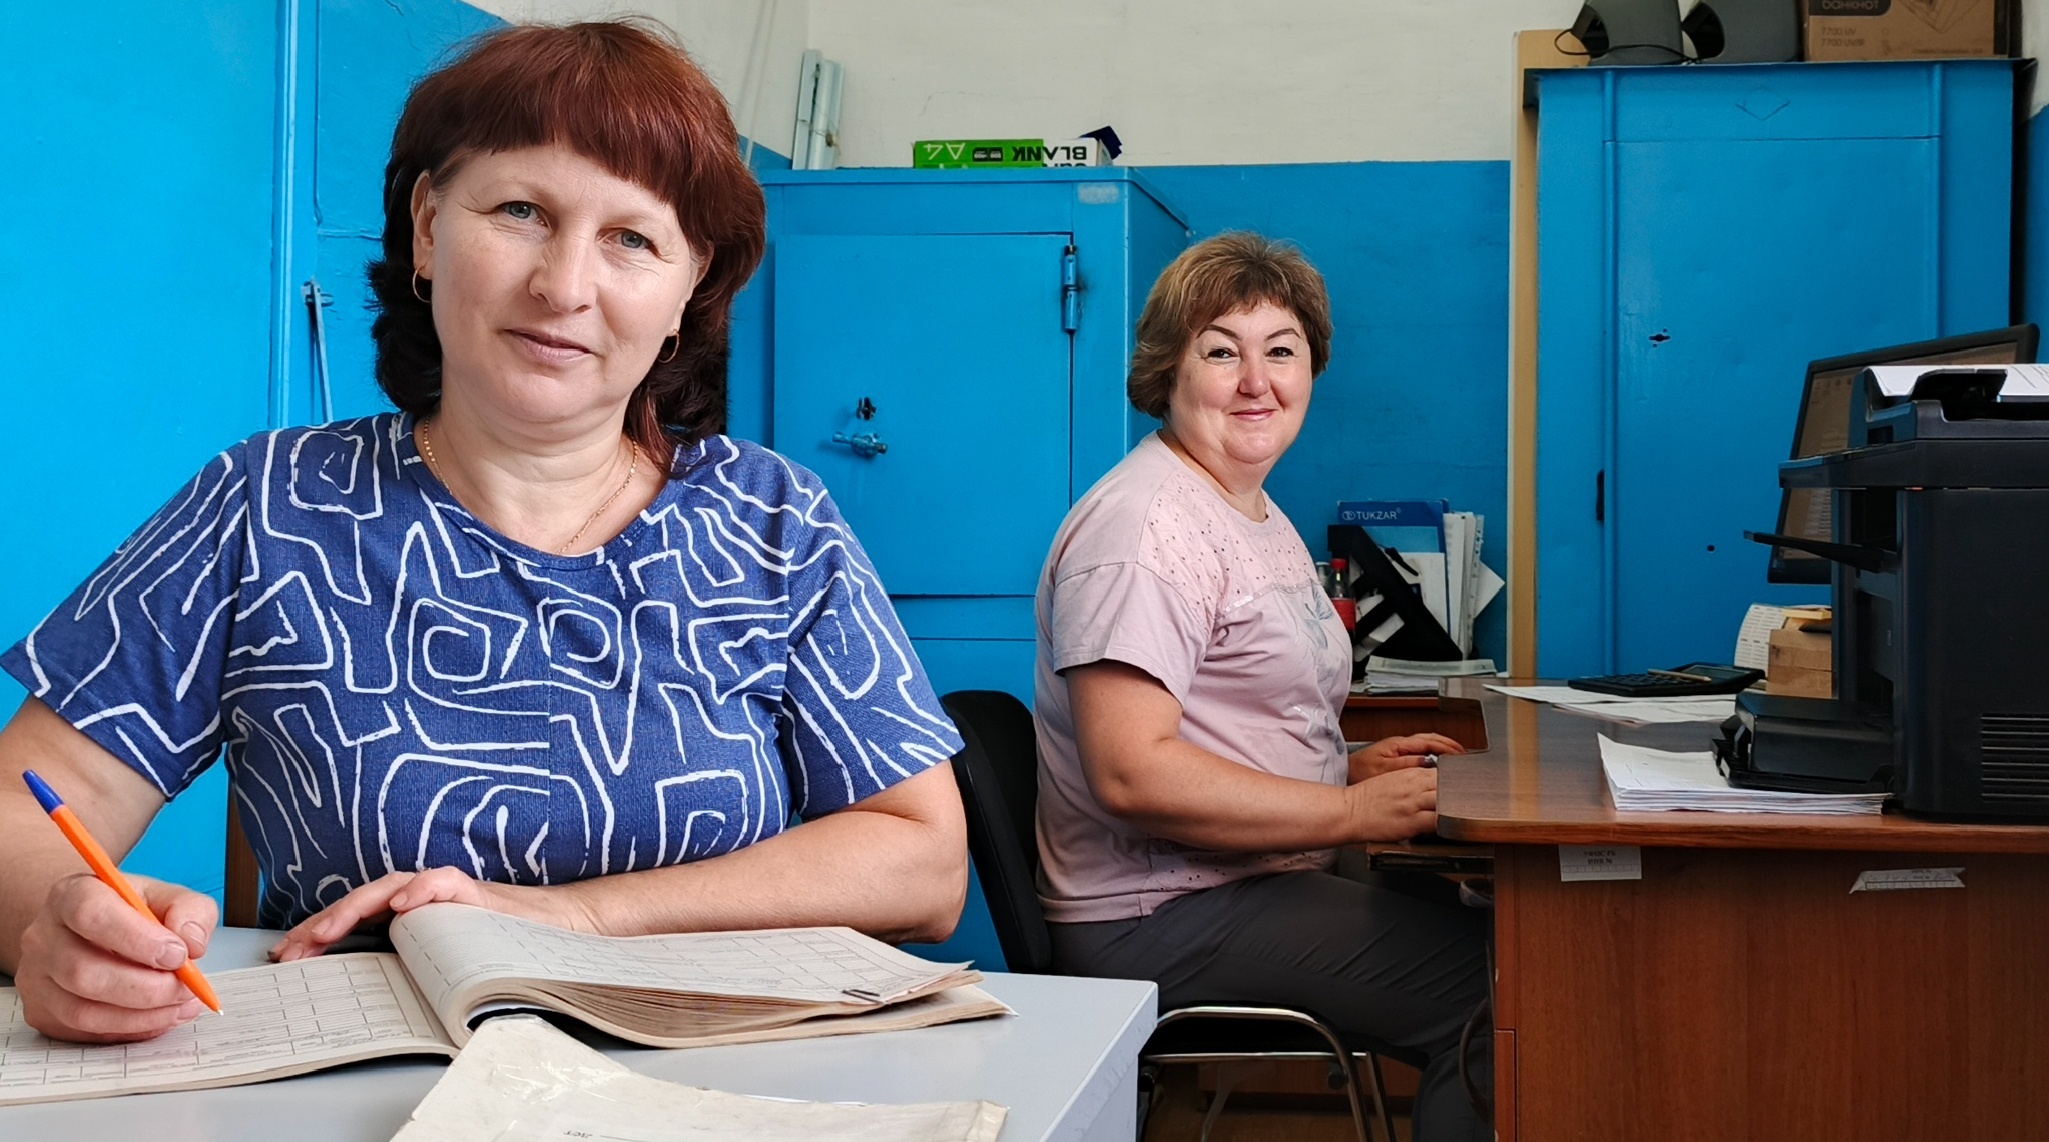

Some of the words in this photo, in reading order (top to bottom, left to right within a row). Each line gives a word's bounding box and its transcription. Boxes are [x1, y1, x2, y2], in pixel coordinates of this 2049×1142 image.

[923, 143, 966, 161] A4
[1012, 146, 1087, 161] BLANK
[1356, 510, 1398, 520] TUKZAR
